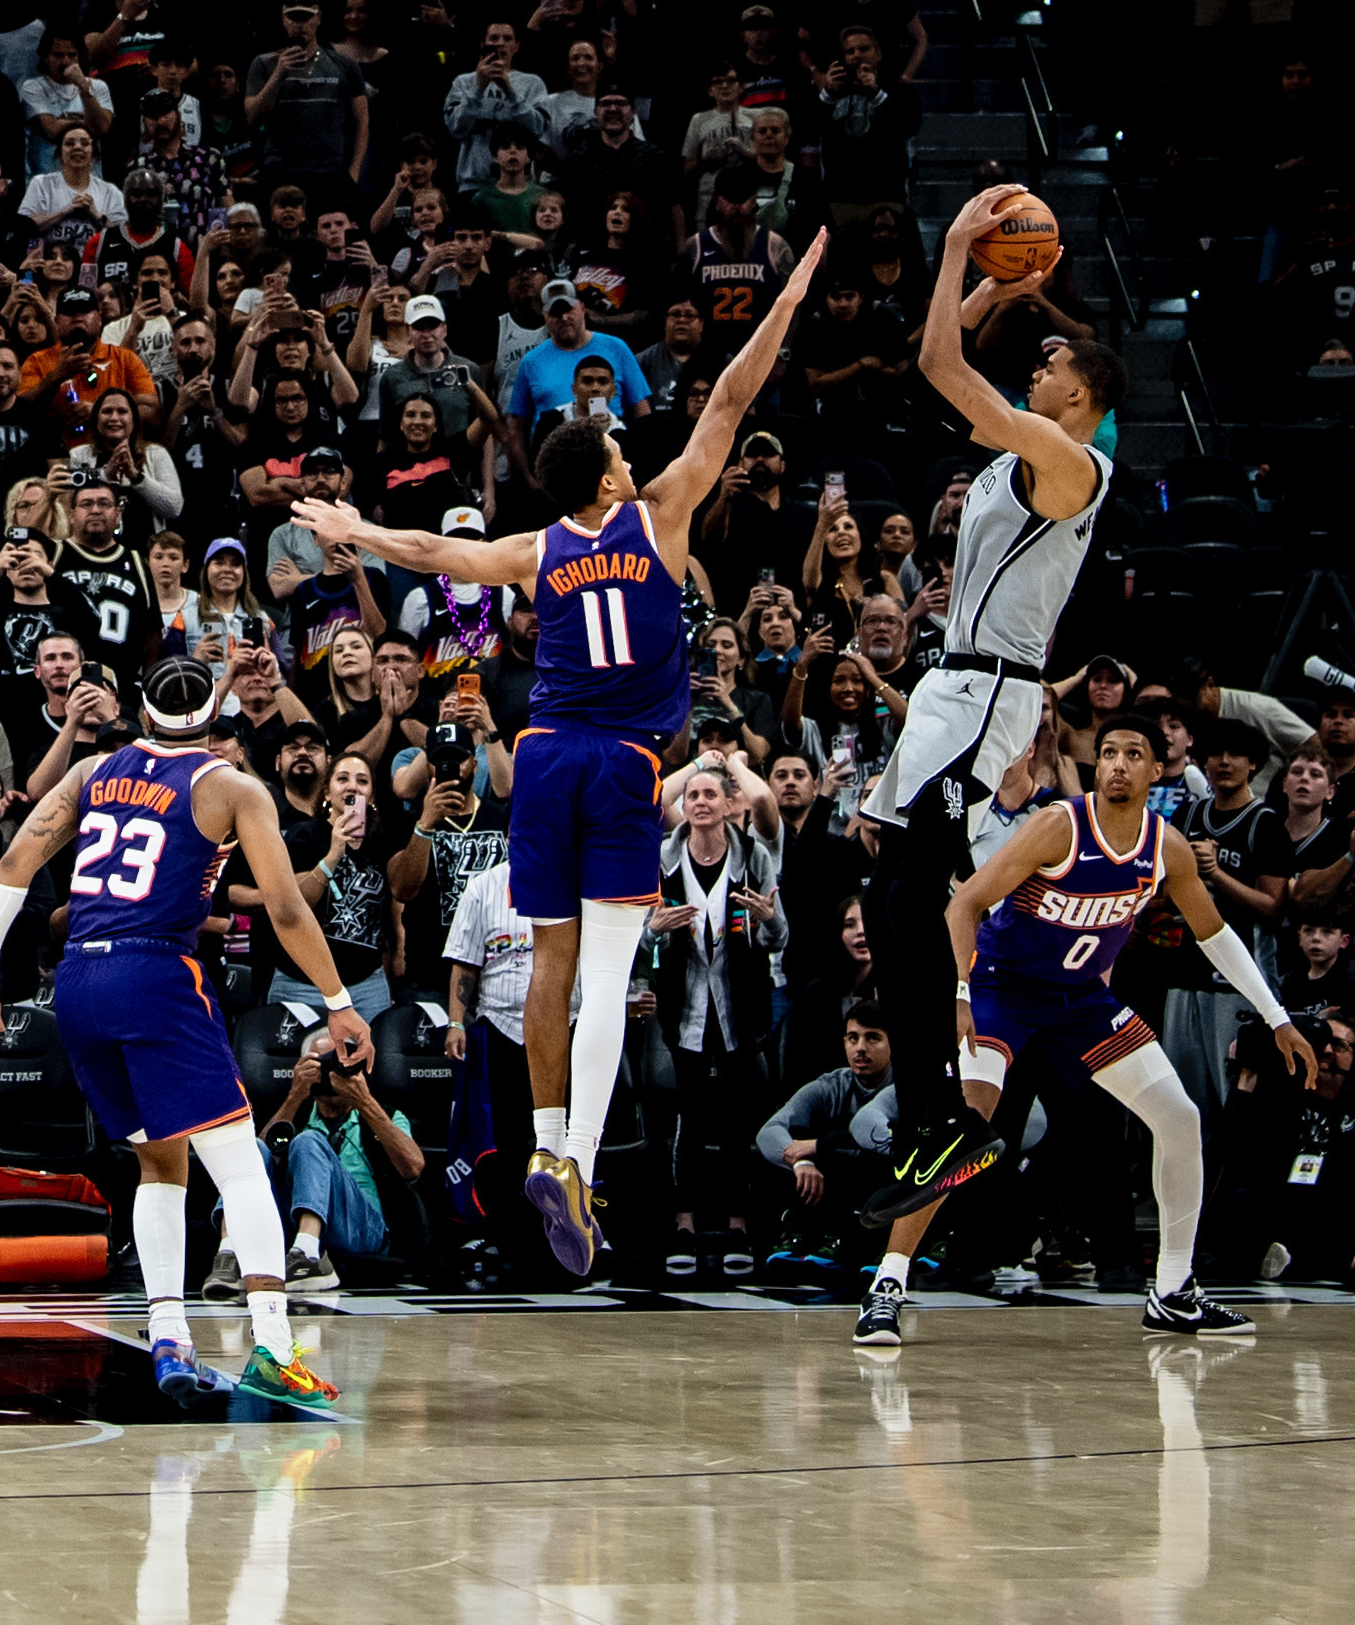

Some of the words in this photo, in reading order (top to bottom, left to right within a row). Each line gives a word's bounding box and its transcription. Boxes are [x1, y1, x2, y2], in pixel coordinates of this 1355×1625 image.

[1000, 215, 1056, 238] Wilson
[700, 261, 767, 285] PHOENIX
[710, 286, 755, 322] 22
[184, 442, 205, 470] 4
[545, 552, 652, 598] IGHODARO
[99, 598, 131, 645] 0
[579, 587, 636, 669] 11
[89, 779, 177, 817] GOODWIN
[69, 811, 169, 903] 23
[1036, 888, 1134, 928] SUNS
[1061, 934, 1096, 971] 0
[14, 1070, 43, 1082] FAST
[409, 1067, 453, 1079] BOOKER
